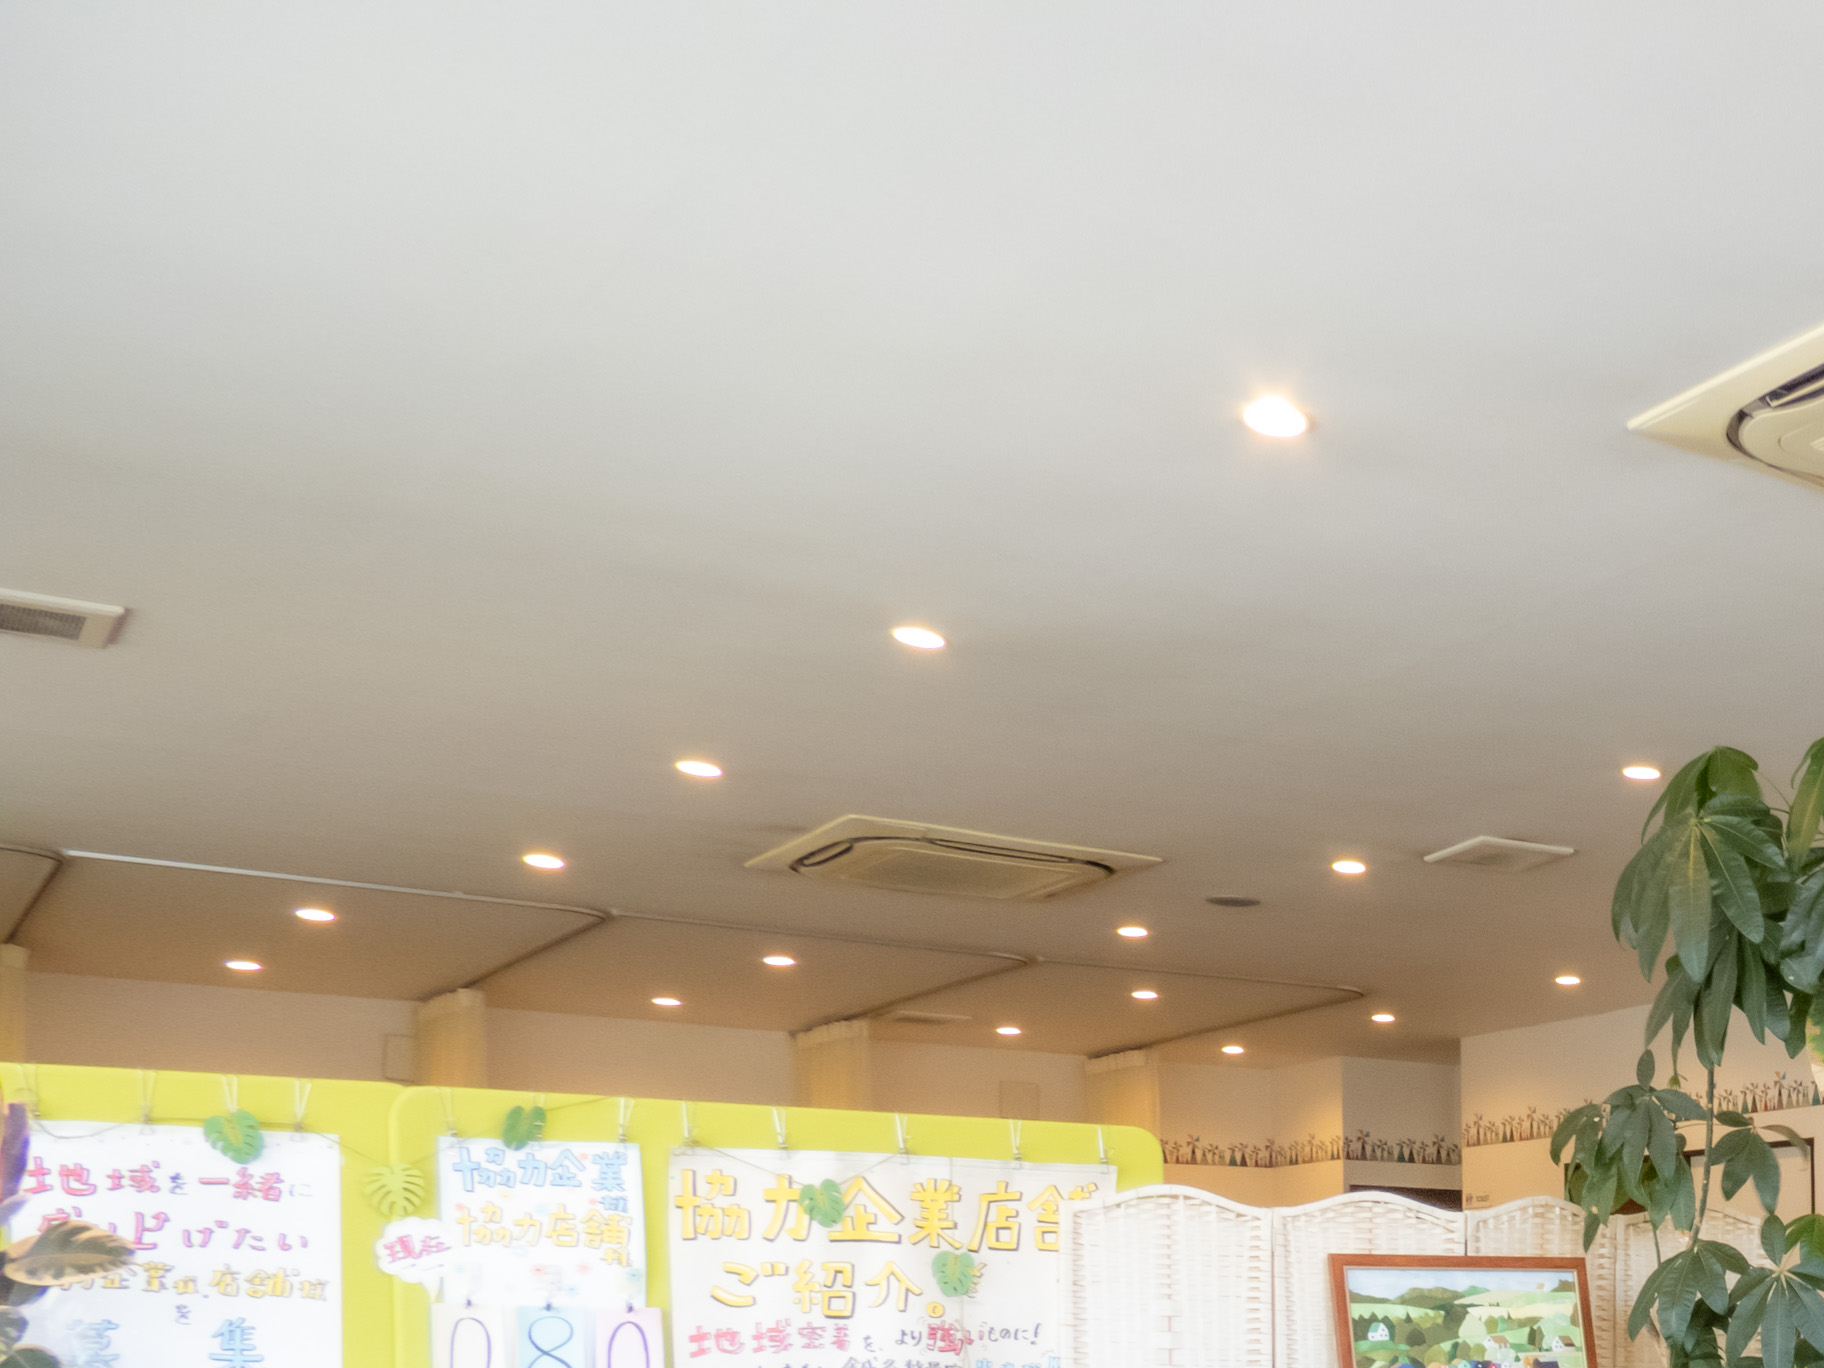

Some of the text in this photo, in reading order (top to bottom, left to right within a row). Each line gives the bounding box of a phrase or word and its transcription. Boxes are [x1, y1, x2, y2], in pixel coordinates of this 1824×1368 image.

[24, 1156, 313, 1202] 地域を一緒に
[382, 1233, 453, 1264] 現在
